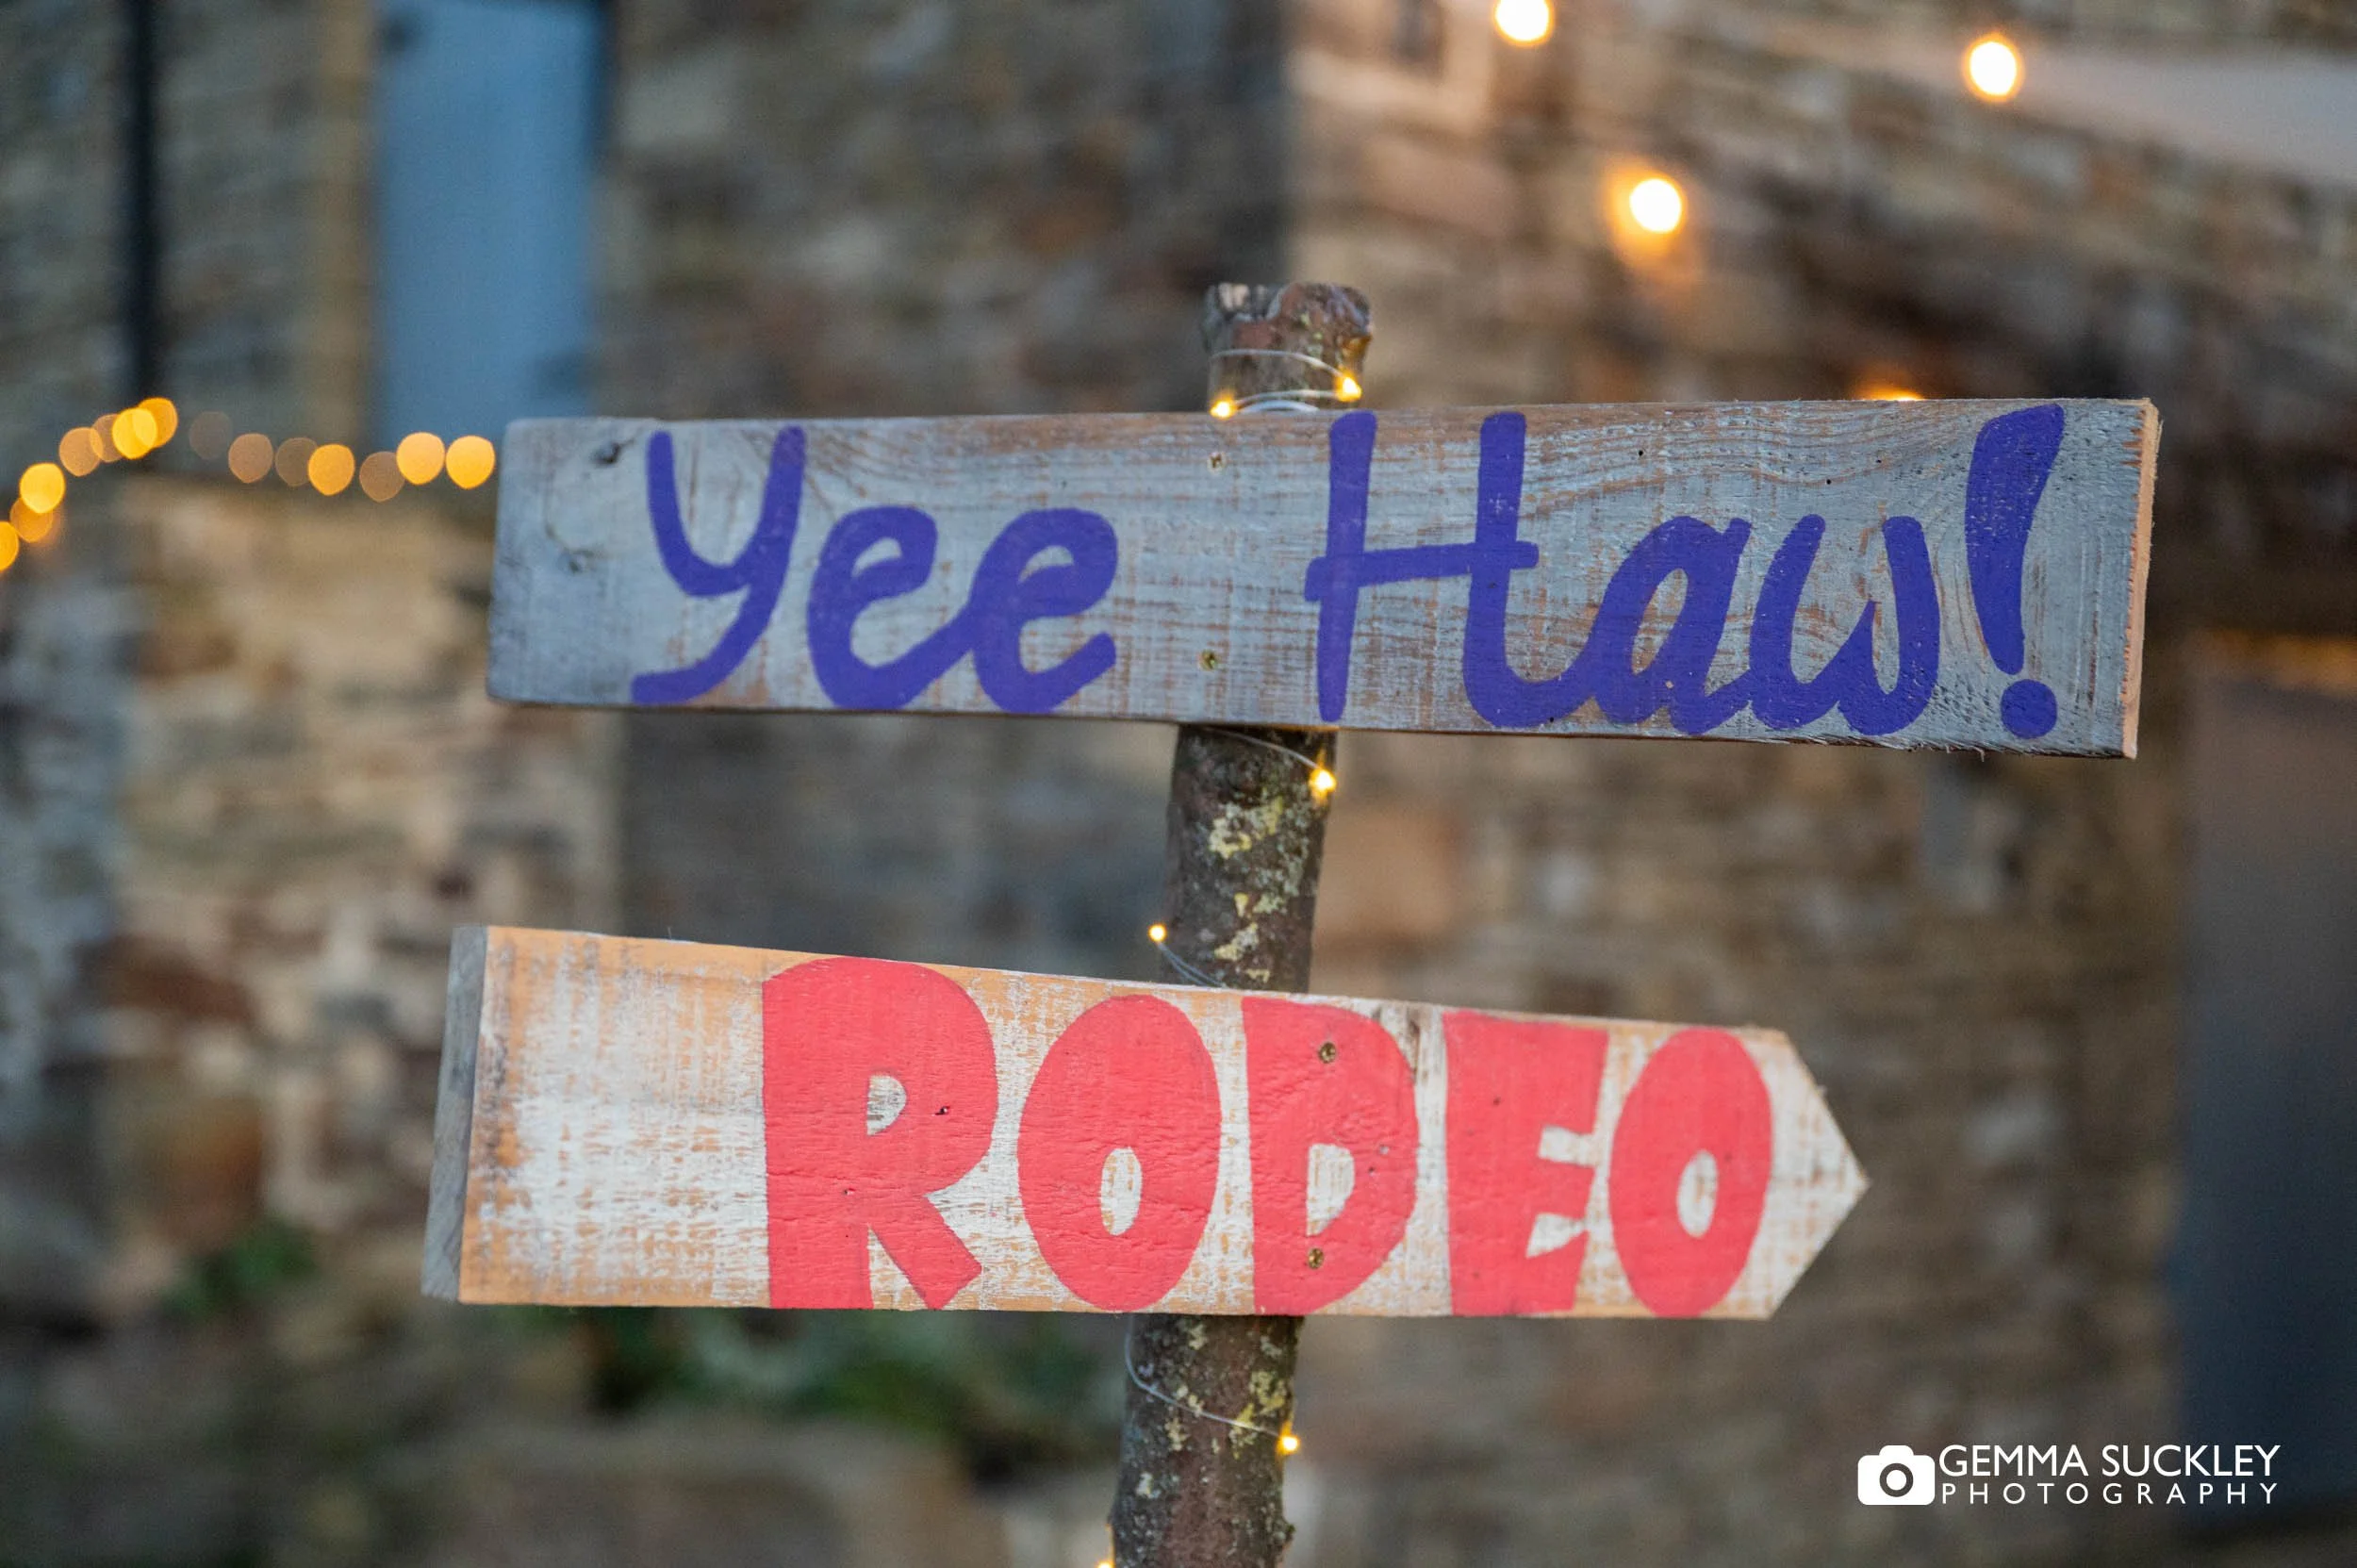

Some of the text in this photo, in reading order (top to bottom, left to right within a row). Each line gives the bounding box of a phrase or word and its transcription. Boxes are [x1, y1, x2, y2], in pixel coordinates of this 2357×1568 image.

[630, 404, 2067, 740] Yee Haw!
[761, 956, 1772, 1319] RODEO
